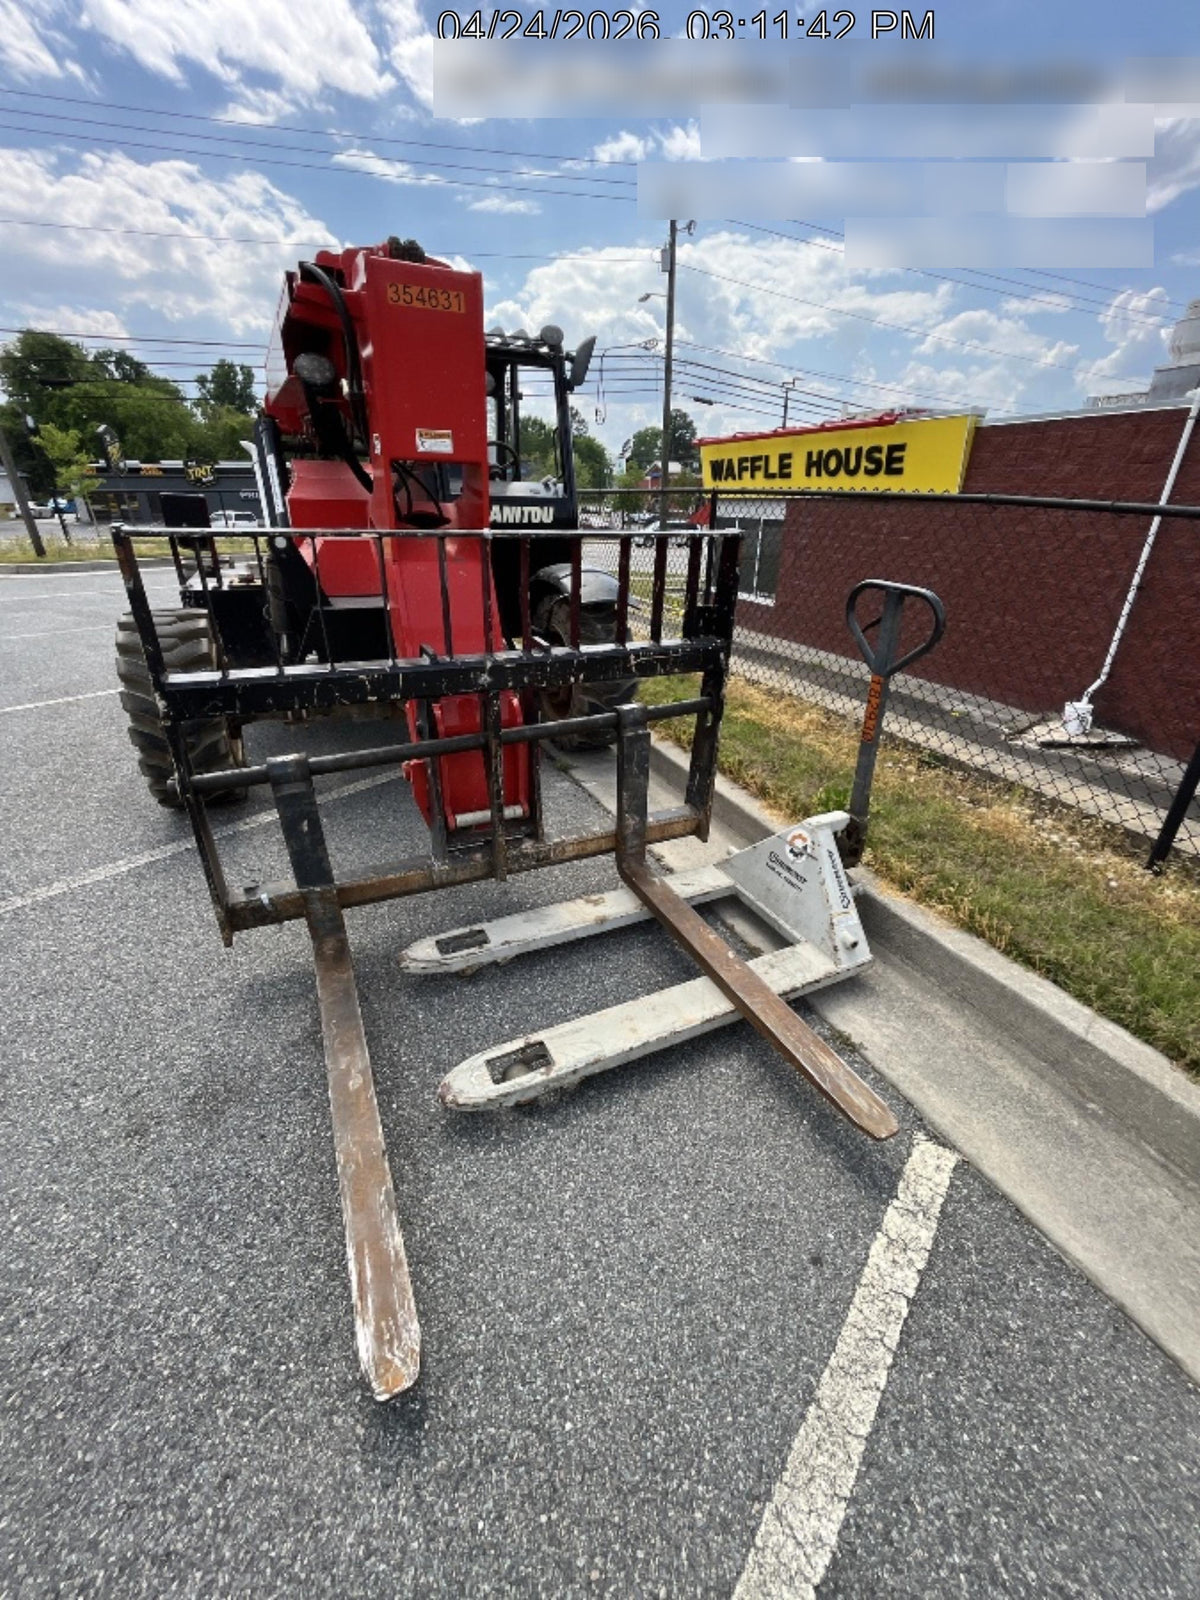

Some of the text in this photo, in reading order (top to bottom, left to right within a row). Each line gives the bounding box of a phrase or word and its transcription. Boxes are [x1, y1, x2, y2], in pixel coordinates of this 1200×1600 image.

[388, 283, 464, 312] 354631
[709, 443, 907, 482] WAFFLE HOUSE
[489, 504, 555, 524] ANITOU
